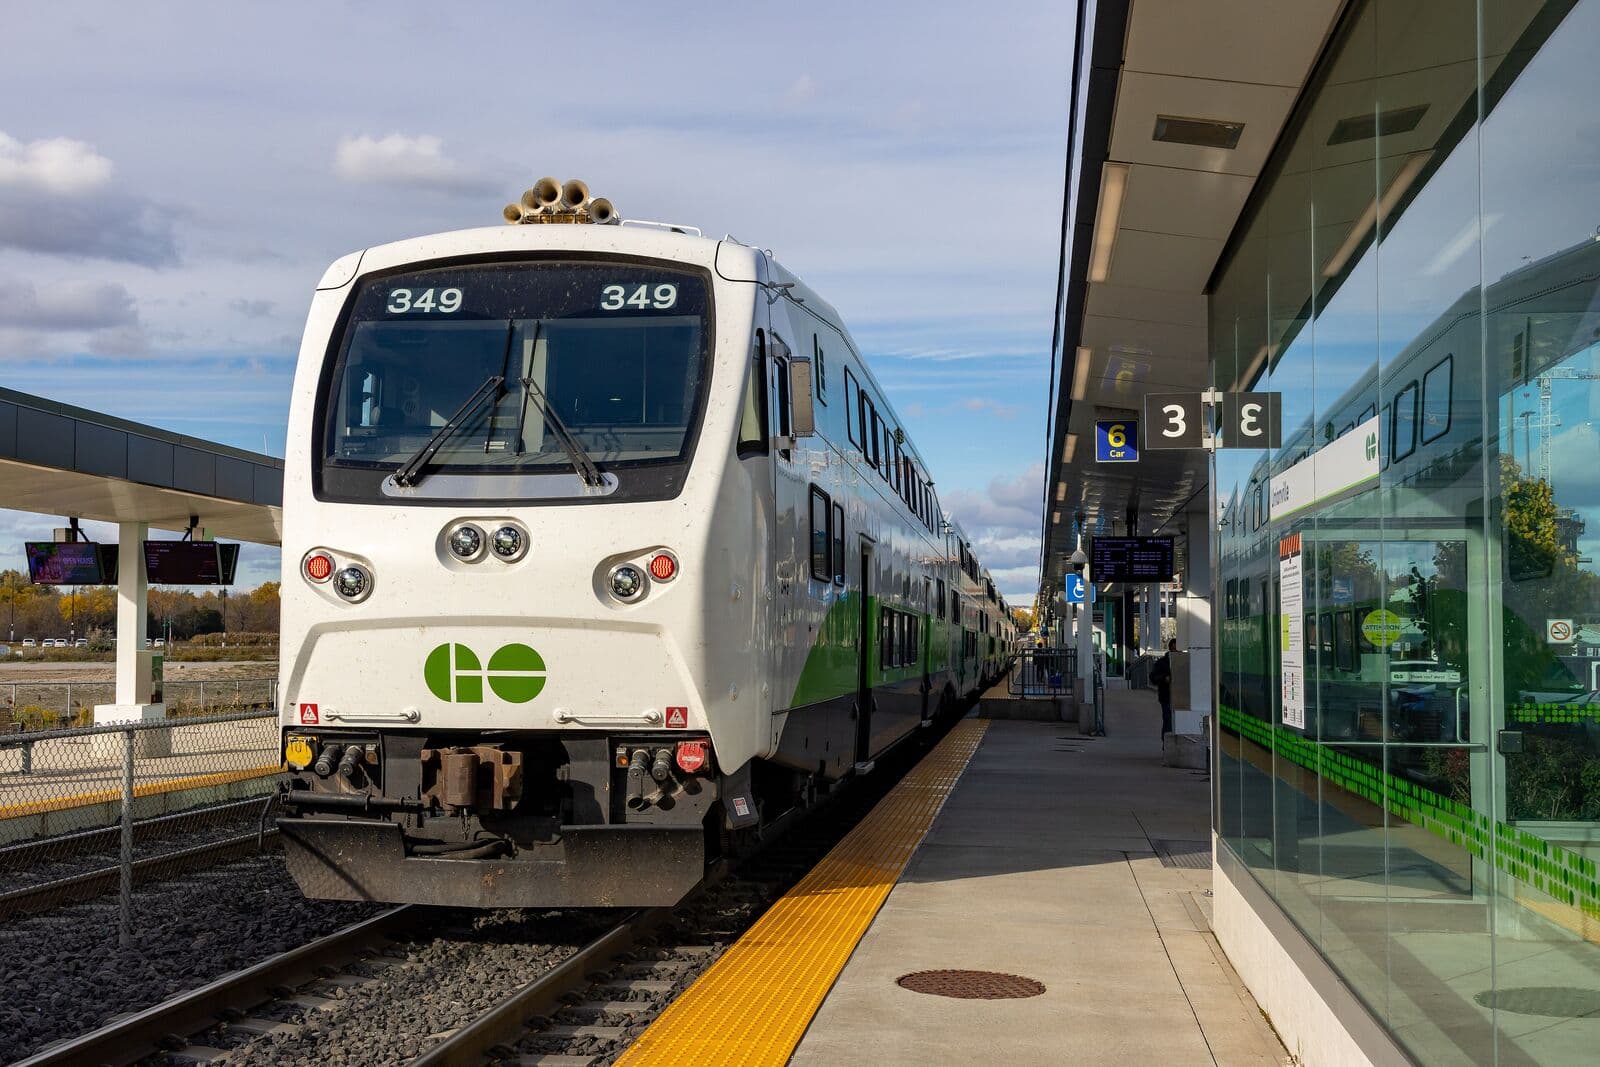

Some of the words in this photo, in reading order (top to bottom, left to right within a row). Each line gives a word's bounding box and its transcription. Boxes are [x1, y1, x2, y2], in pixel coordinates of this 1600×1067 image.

[387, 288, 463, 313] 349
[600, 284, 677, 310] 349
[1162, 404, 1186, 438] 3
[1108, 424, 1126, 448] 6
[1109, 449, 1125, 458] Car
[424, 642, 546, 703] GO
